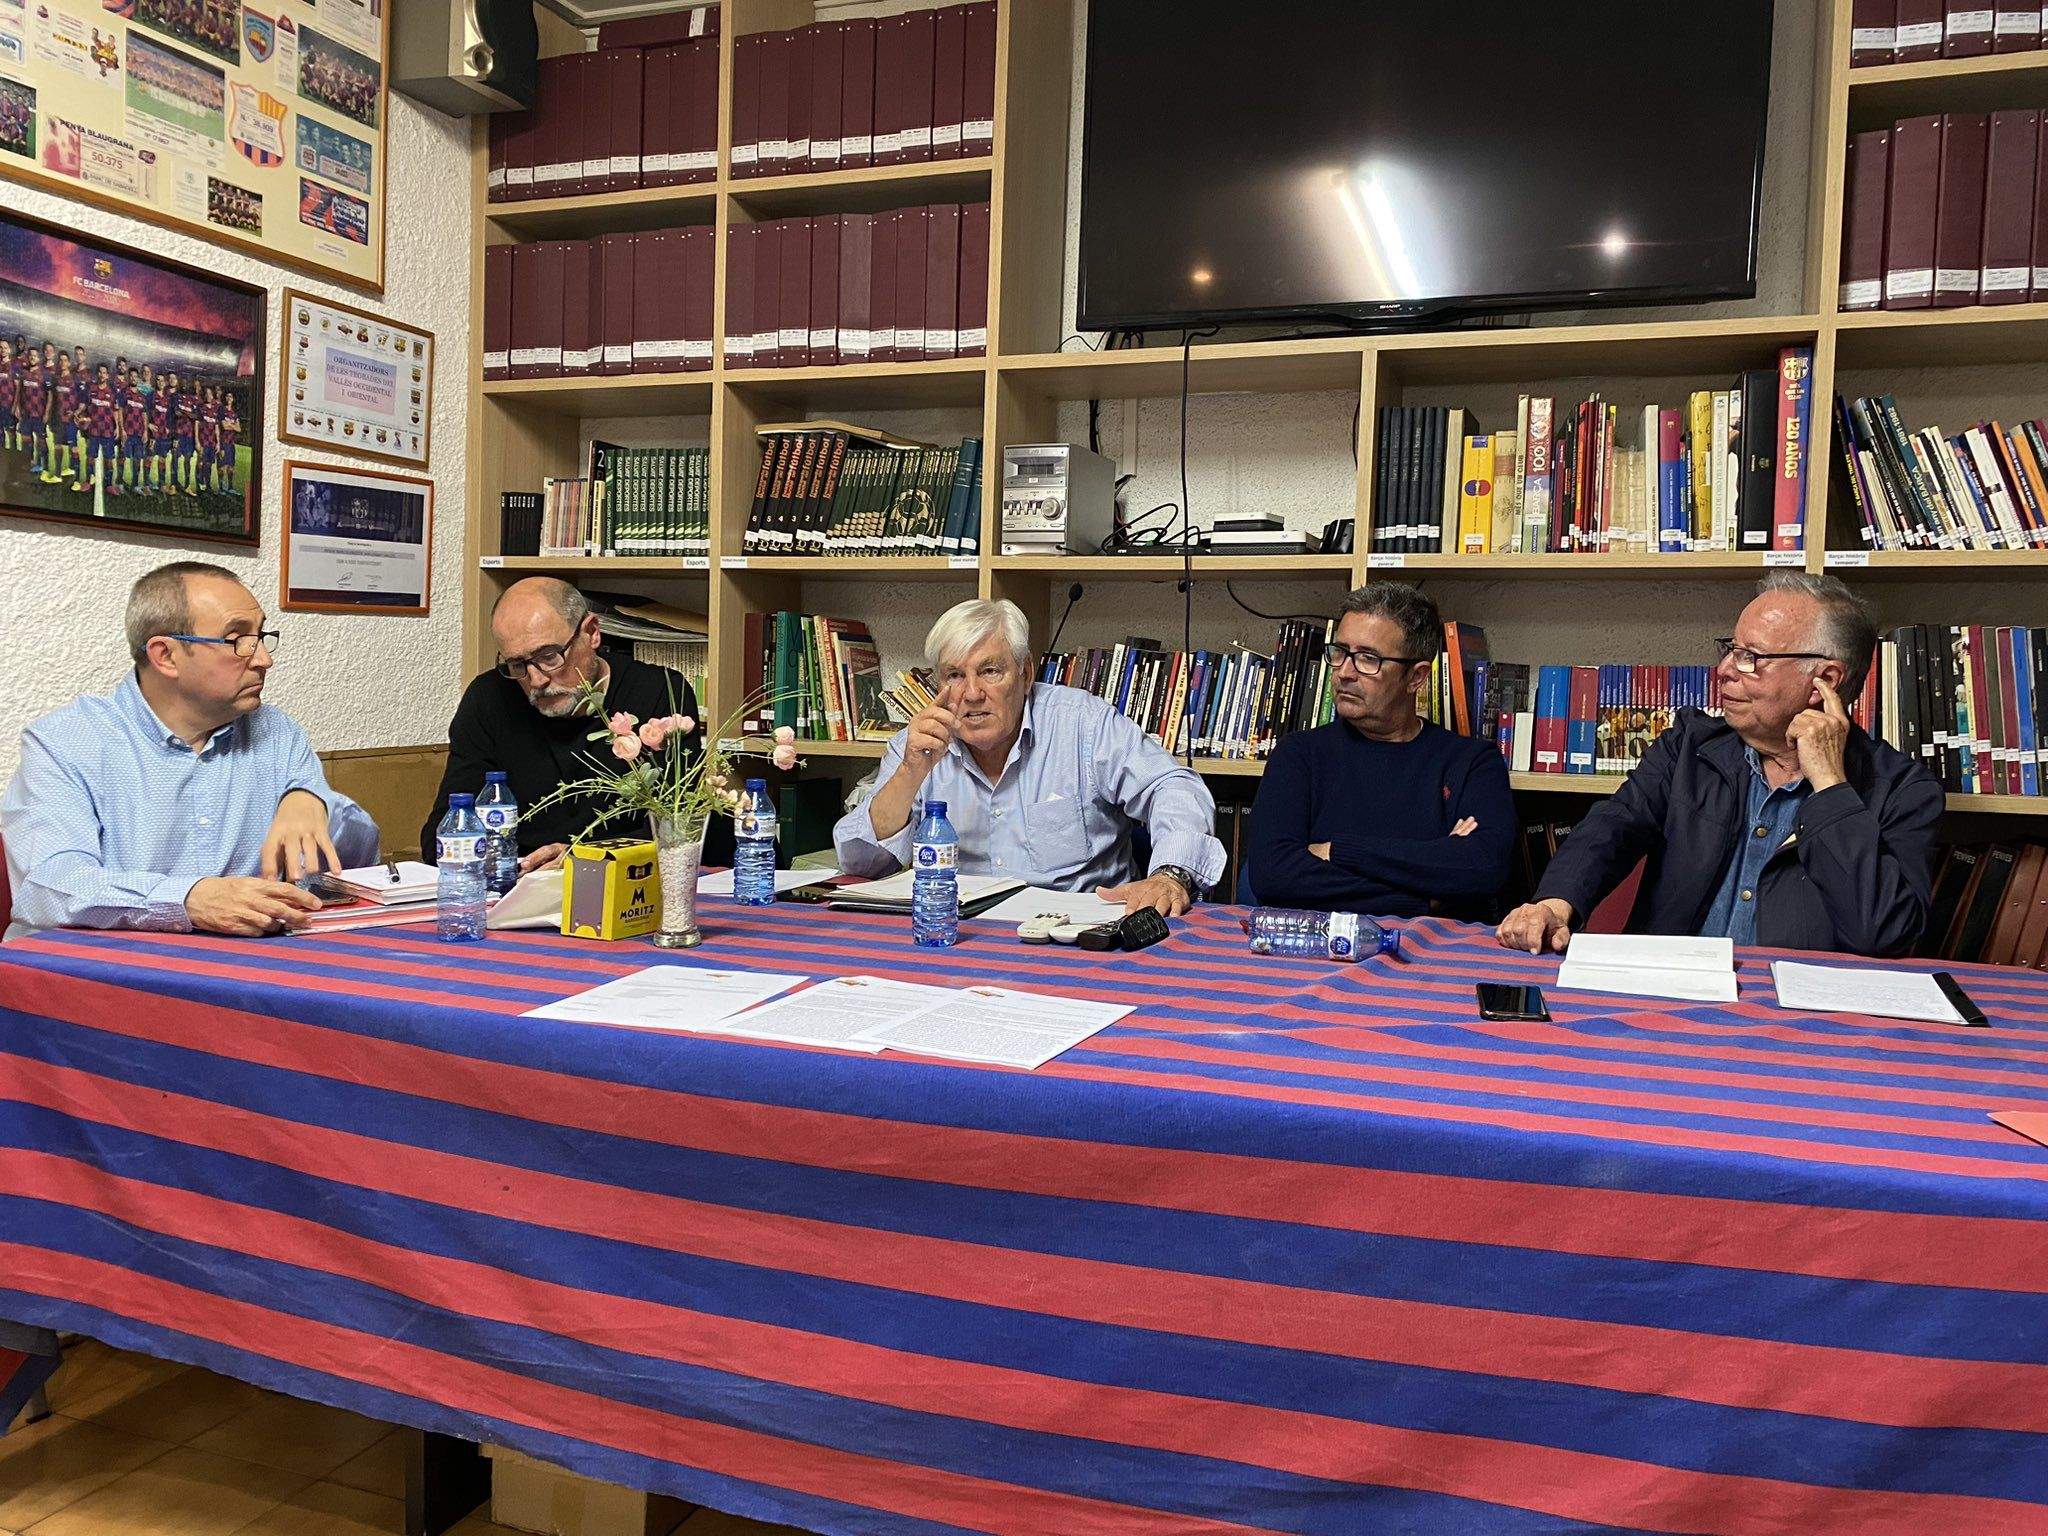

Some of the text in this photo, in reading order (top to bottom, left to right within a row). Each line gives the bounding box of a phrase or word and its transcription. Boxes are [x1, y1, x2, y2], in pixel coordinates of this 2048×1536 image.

[72, 276, 130, 298] FC BARCELONA
[1784, 416, 1802, 479] 120 AÑOS
[1533, 446, 1546, 472] 100
[1911, 465, 1931, 498] BARÇA
[1533, 478, 1543, 514] BARÇA
[1923, 496, 1935, 511] del
[1954, 850, 1976, 864] PENYES
[1992, 850, 2013, 862] PENYES
[632, 887, 645, 905] M
[620, 905, 655, 919] MORITZ
